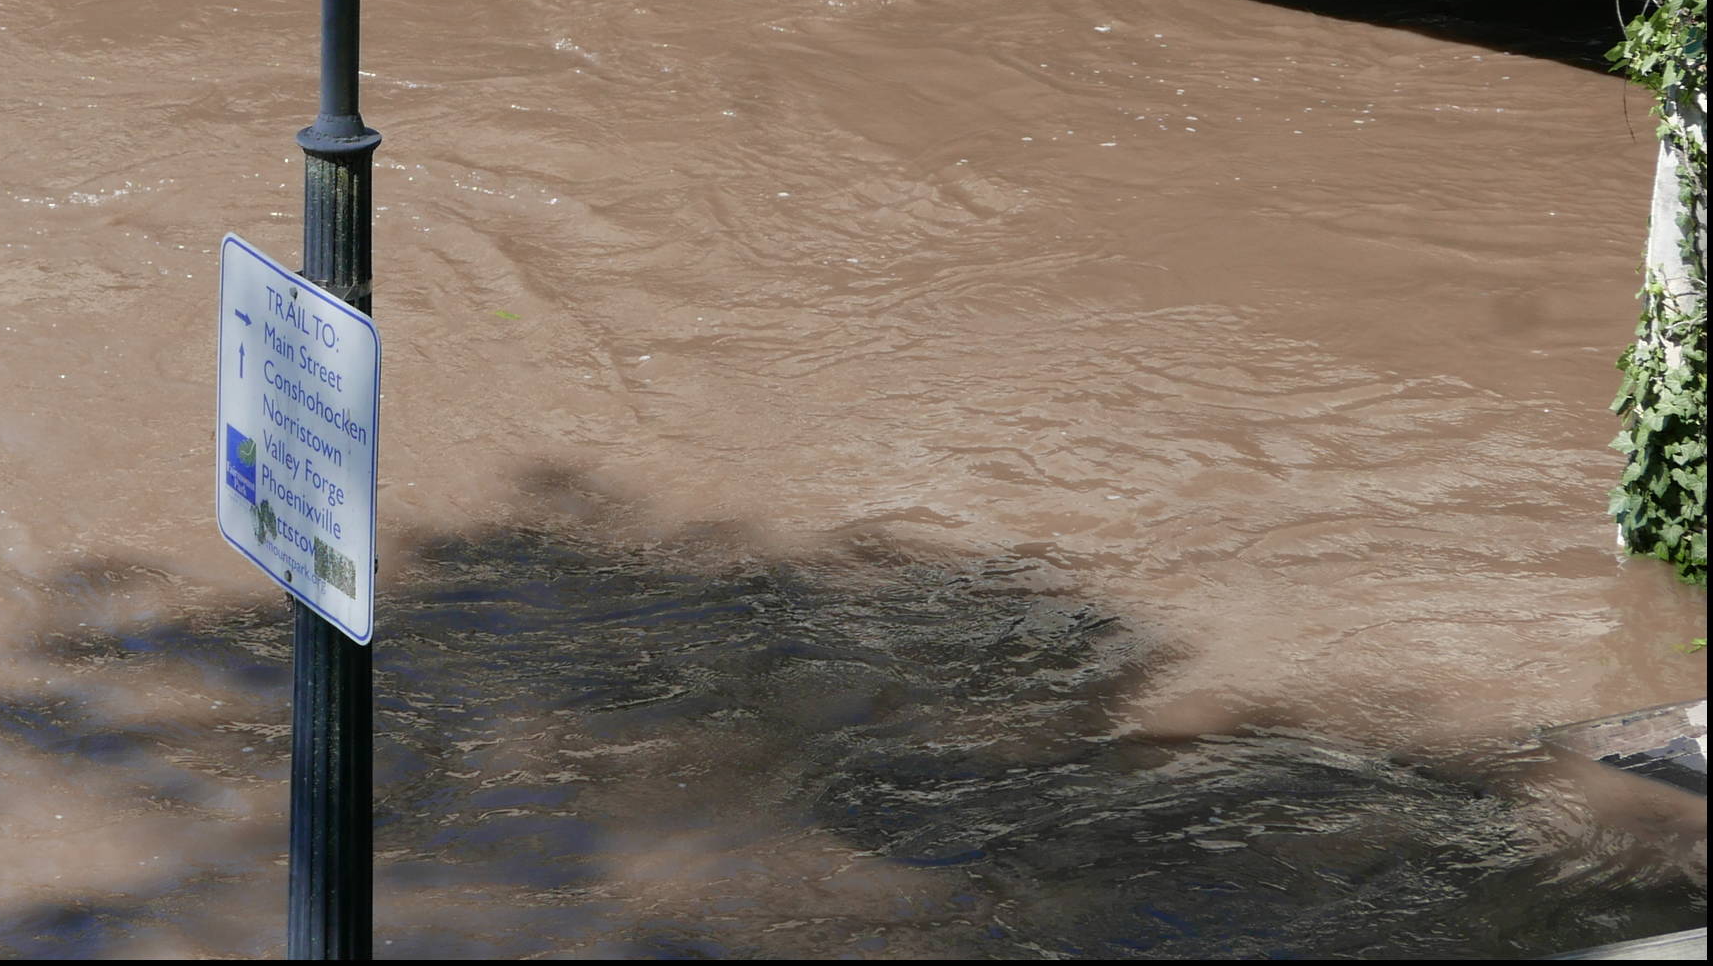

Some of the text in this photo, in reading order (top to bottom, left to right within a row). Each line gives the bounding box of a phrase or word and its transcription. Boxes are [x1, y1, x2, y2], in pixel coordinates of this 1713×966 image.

[264, 321, 342, 392] Main Street
[266, 285, 340, 353] TRAIL TO:
[263, 393, 342, 467] Norristown
[264, 360, 367, 445] Conshohocken
[262, 463, 342, 540] Phoenixville
[263, 430, 300, 479] Valley
[305, 459, 344, 506] Forge
